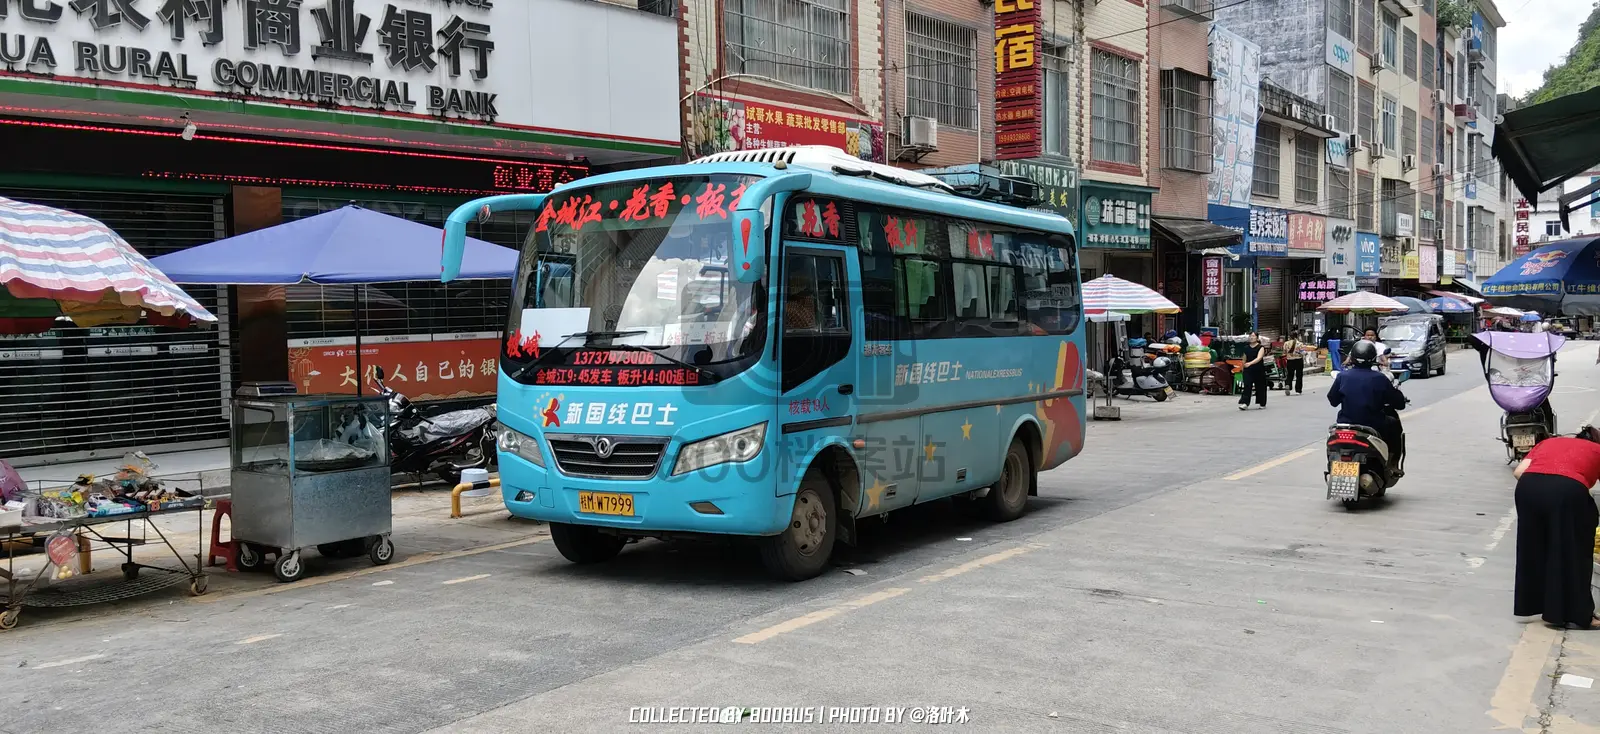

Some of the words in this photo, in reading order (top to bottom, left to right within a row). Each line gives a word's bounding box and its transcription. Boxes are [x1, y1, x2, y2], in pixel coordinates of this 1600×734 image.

[0, 0, 494, 81] 村商业银行
[1333, 44, 1349, 64] oppo
[73, 40, 198, 82] RURAL
[211, 58, 416, 107] COMMERCIAL
[426, 85, 498, 117] BANK
[745, 122, 763, 135] 主营:
[746, 106, 783, 125] 斌哥水果
[786, 112, 846, 135] 蔬菜批发零售部
[802, 199, 840, 238] 花香
[1360, 237, 1375, 254] vivo
[1206, 259, 1219, 295] 窗帘批发
[573, 350, 655, 365] 13737973006
[617, 368, 699, 385] 板升14:00返回
[895, 361, 963, 387] 新国线巴士
[563, 402, 679, 426] 新国线巴士
